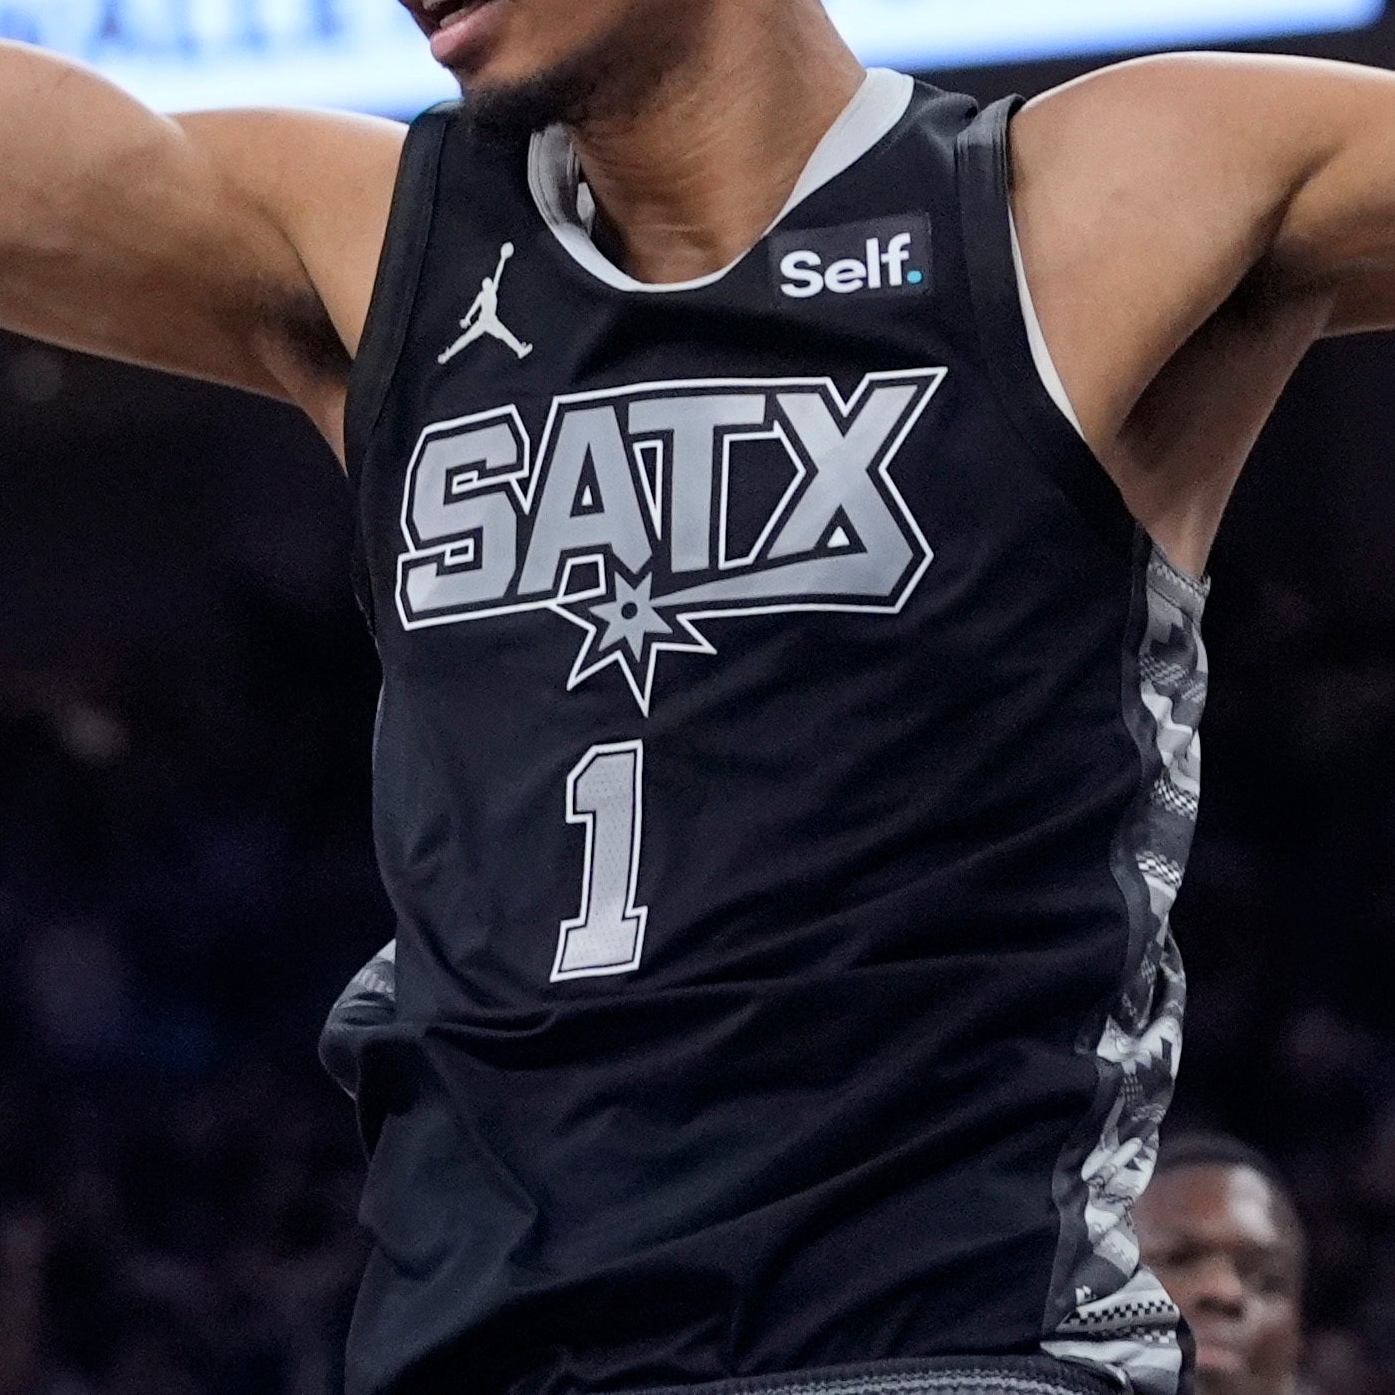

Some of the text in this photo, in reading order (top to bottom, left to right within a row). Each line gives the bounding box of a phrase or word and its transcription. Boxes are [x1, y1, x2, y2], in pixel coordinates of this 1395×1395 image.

[779, 231, 924, 299] Self.
[396, 366, 947, 630] SATX
[550, 740, 648, 982] 1
